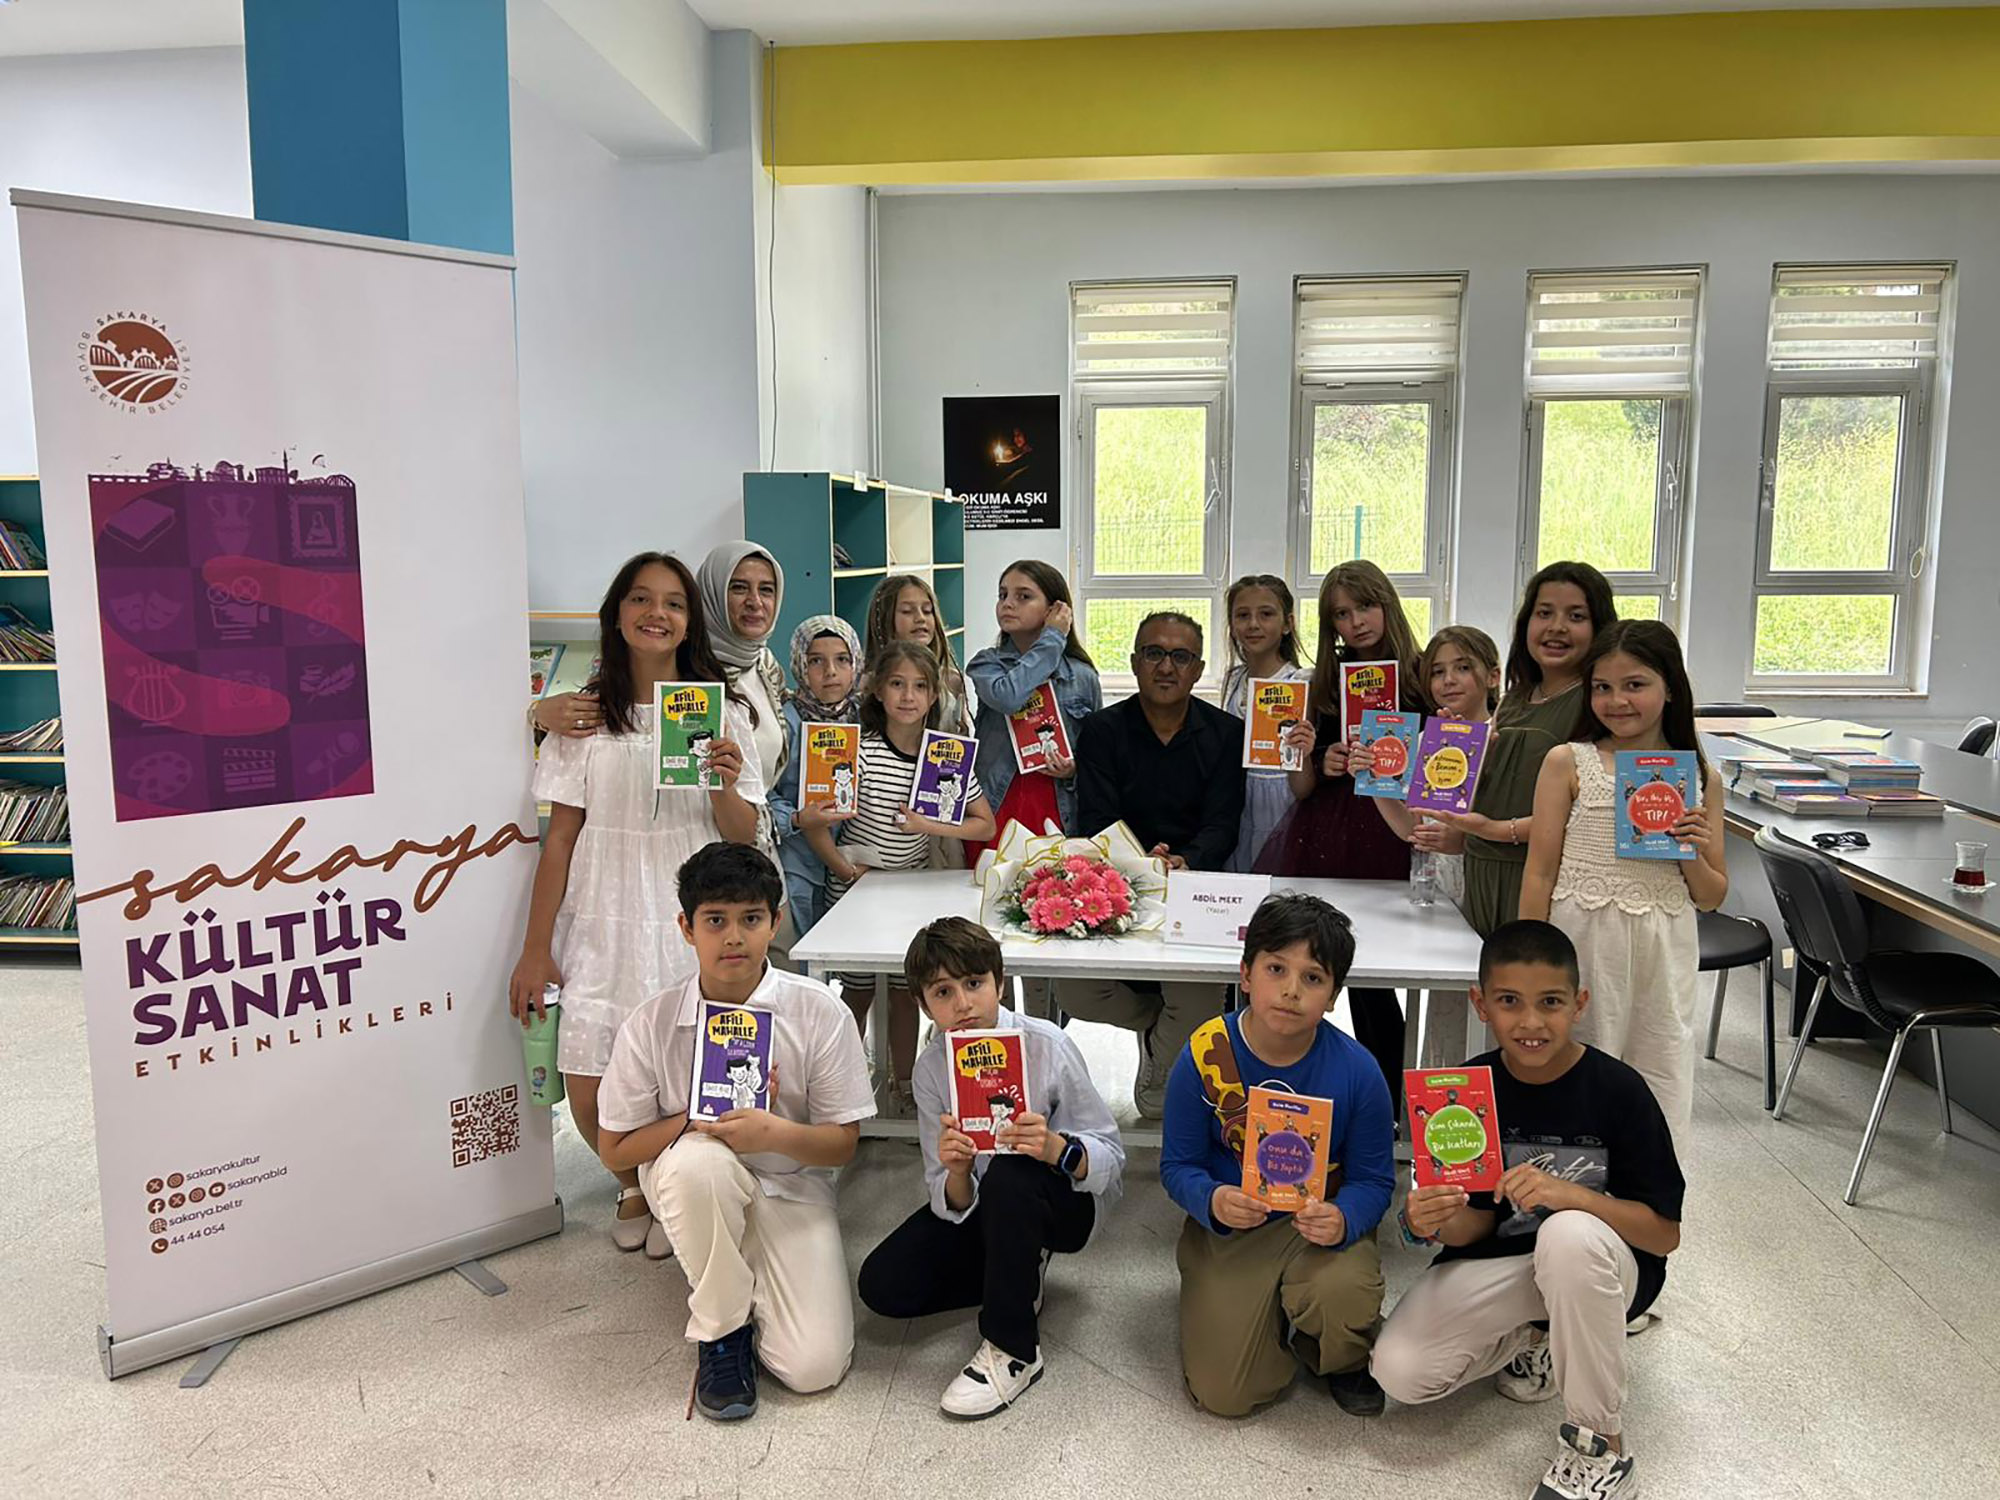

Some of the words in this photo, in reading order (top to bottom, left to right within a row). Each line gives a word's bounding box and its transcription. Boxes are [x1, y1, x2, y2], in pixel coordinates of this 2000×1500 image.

[96, 310, 167, 332] SAKARYA
[959, 493, 1011, 505] OKUMA
[1014, 492, 1048, 507] AŞKI
[76, 816, 539, 921] sakarya
[125, 887, 406, 988] KÜLTÜR
[133, 957, 362, 1046] SANAT
[135, 991, 453, 1078] ETKİNLİKLERİ
[186, 1155, 260, 1182] sakaryakultur
[227, 1166, 287, 1191] sakaryabld
[168, 1199, 244, 1227] sakarya.bel.tr
[170, 1234, 185, 1245] 44
[187, 1229, 201, 1240] 44
[203, 1223, 225, 1237] 054
